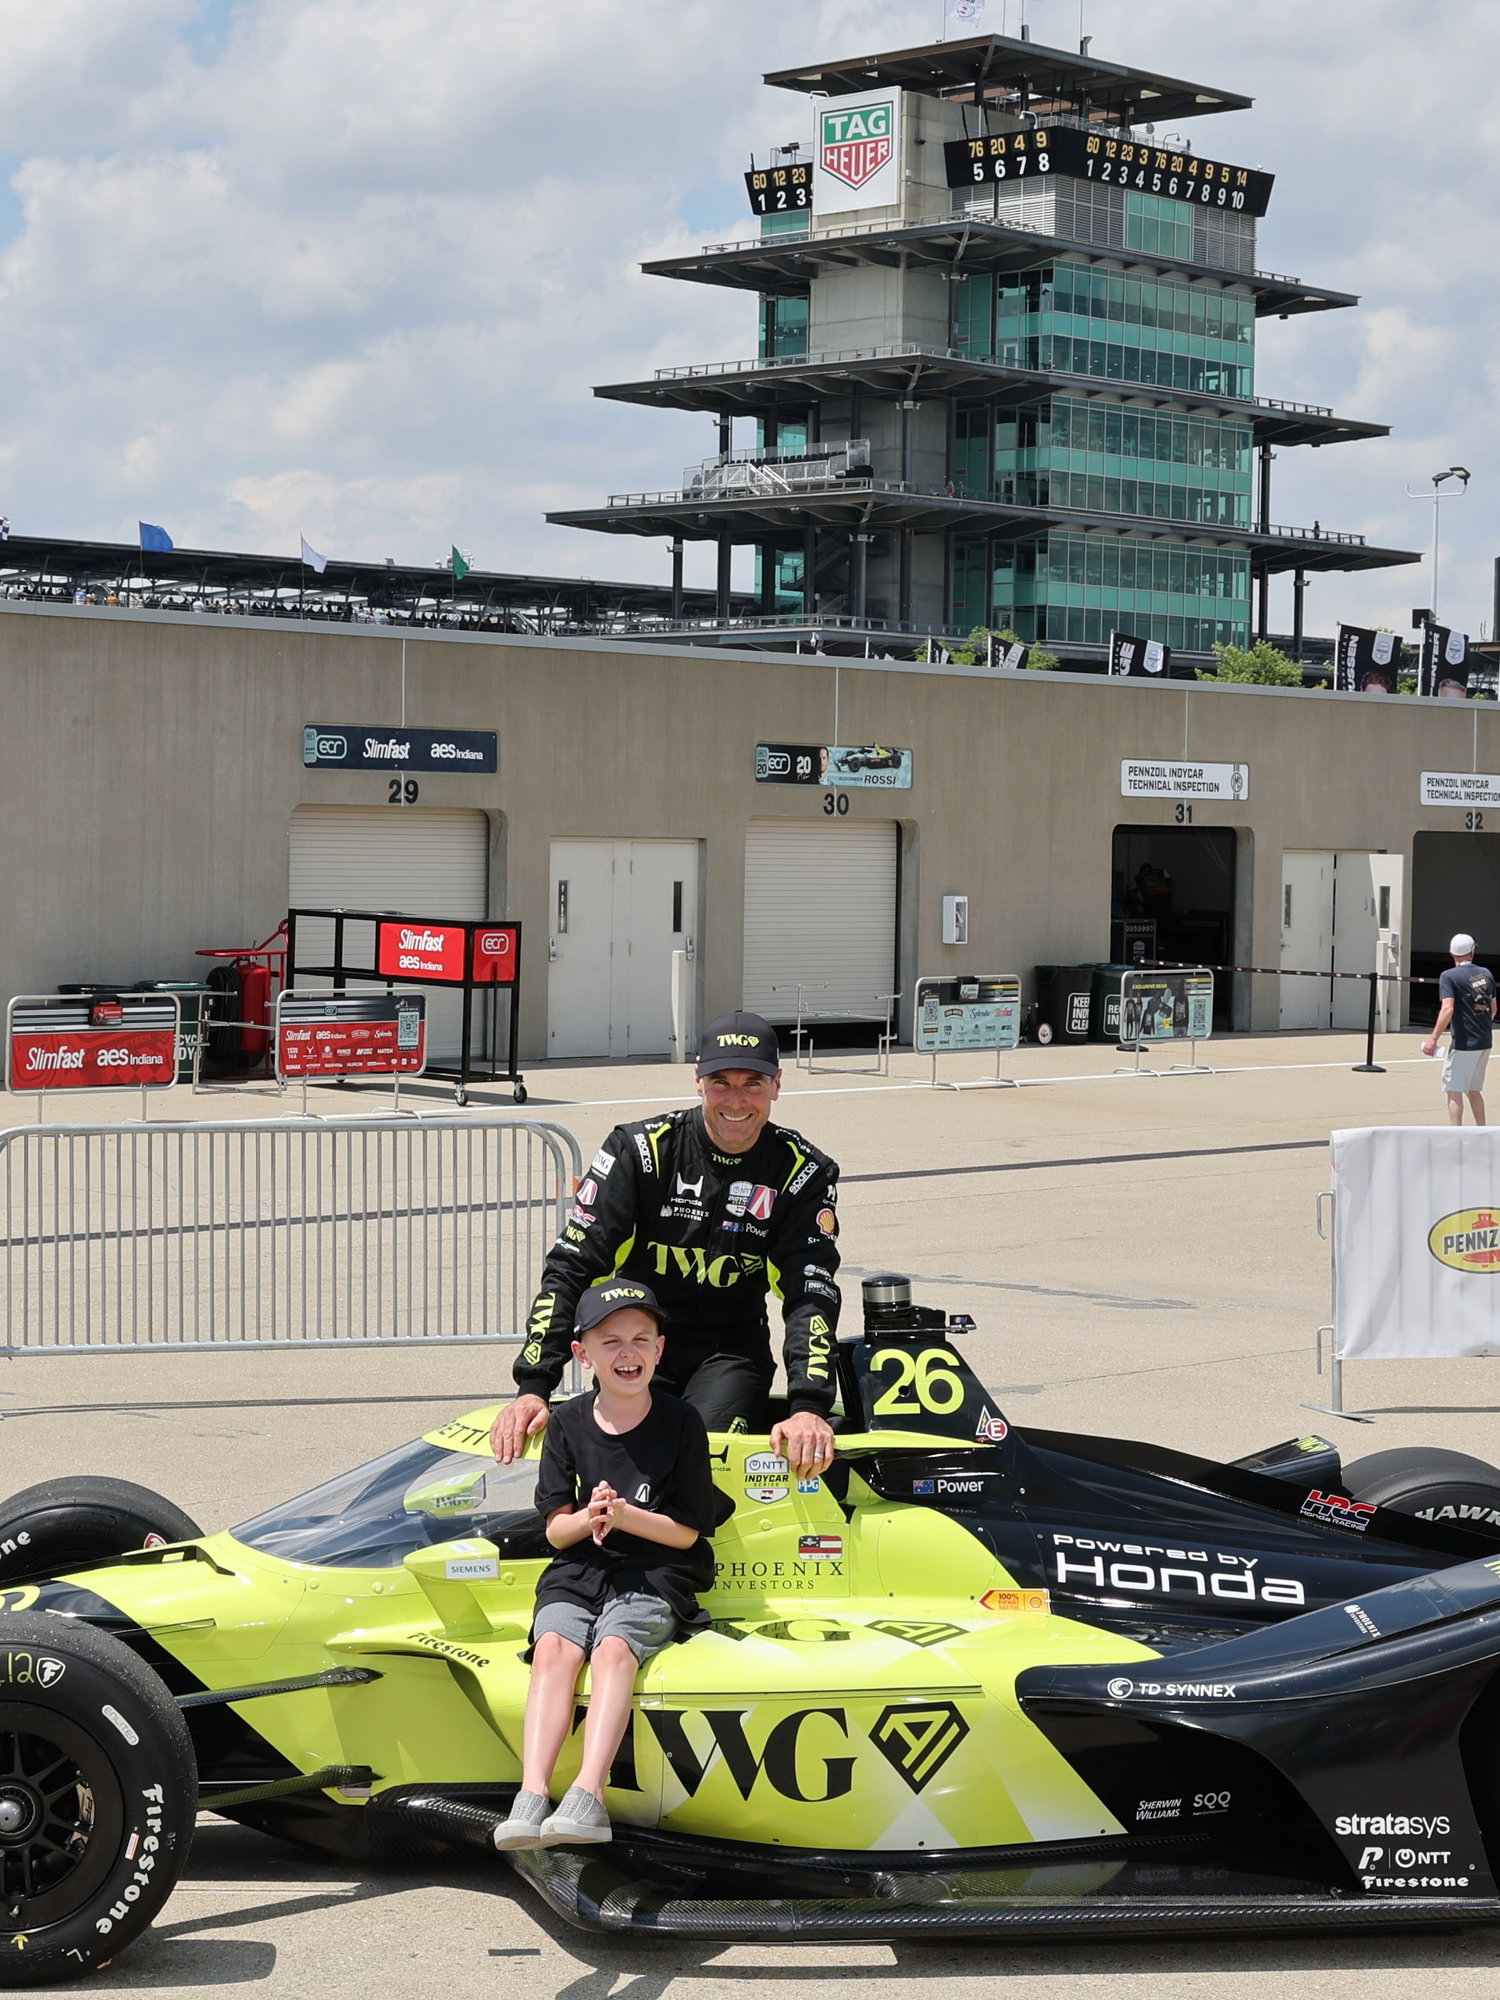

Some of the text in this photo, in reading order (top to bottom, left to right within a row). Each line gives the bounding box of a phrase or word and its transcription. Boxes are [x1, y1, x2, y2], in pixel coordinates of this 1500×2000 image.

[828, 110, 886, 140] TAG
[969, 131, 1047, 158] 76 20 4 9
[826, 141, 888, 181] HEUER
[973, 153, 1049, 181] 5 6 7 8
[1087, 136, 1248, 187] 60 12 23 3 76 20 4 9 5 14
[753, 167, 805, 189] 60 12 23
[1086, 159, 1245, 210] 1 2 3 4 5 6 7 8 9 10
[758, 188, 806, 211] 1 2 3
[1347, 635, 1359, 692] USSEN
[319, 741, 342, 754] ecr
[431, 743, 456, 758] aes
[456, 749, 484, 760] Indiana
[796, 756, 811, 774] 20
[1128, 766, 1203, 779] PENNZOIL INDYCAR
[864, 774, 896, 785] ROSSI
[1128, 779, 1220, 792] TECHNICAL INSPECTION
[1427, 777, 1489, 789] PENNZOIL INDYCAR
[388, 779, 419, 804] 29
[1427, 789, 1463, 800] TECHNICAL
[823, 792, 849, 815] 30
[1175, 803, 1192, 823] 31
[1465, 812, 1483, 830] 32
[485, 938, 505, 949] ecr
[399, 955, 443, 972] aes Indiana
[717, 1034, 748, 1047] TWG
[96, 1048, 163, 1067] aes Indiana
[634, 1133, 653, 1173] sparco
[789, 1161, 818, 1195] sparco
[671, 1196, 702, 1207] Honda
[647, 1241, 741, 1288] TWG
[601, 1288, 636, 1301] TWG
[529, 1293, 556, 1342] TWG
[807, 1336, 830, 1381] TWG
[870, 1348, 964, 1415] 26
[439, 1420, 490, 1446] ETTI
[991, 1423, 1002, 1436] E
[762, 1460, 785, 1470] NTT
[744, 1474, 789, 1483] INDYCAR
[938, 1479, 984, 1493] Power
[1301, 1489, 1377, 1526] HRC
[1300, 1509, 1366, 1532] Honda RACING
[1053, 1533, 1259, 1569] Powered by
[451, 1565, 491, 1573] SIEMENS
[715, 1562, 844, 1576] PHOENIX
[1056, 1551, 1305, 1605] Honda
[714, 1580, 814, 1590] INVESTORS
[406, 1632, 490, 1668] Firestone
[1138, 1682, 1236, 1698] TD SYNNEX
[1138, 1798, 1182, 1811] SHERWIN
[1136, 1809, 1181, 1820] WILLIAMS
[1335, 1813, 1450, 1839] stratasys
[96, 1783, 164, 1934] Firestone
[1418, 1852, 1452, 1864] NTT
[1362, 1876, 1469, 1889] Firestone
